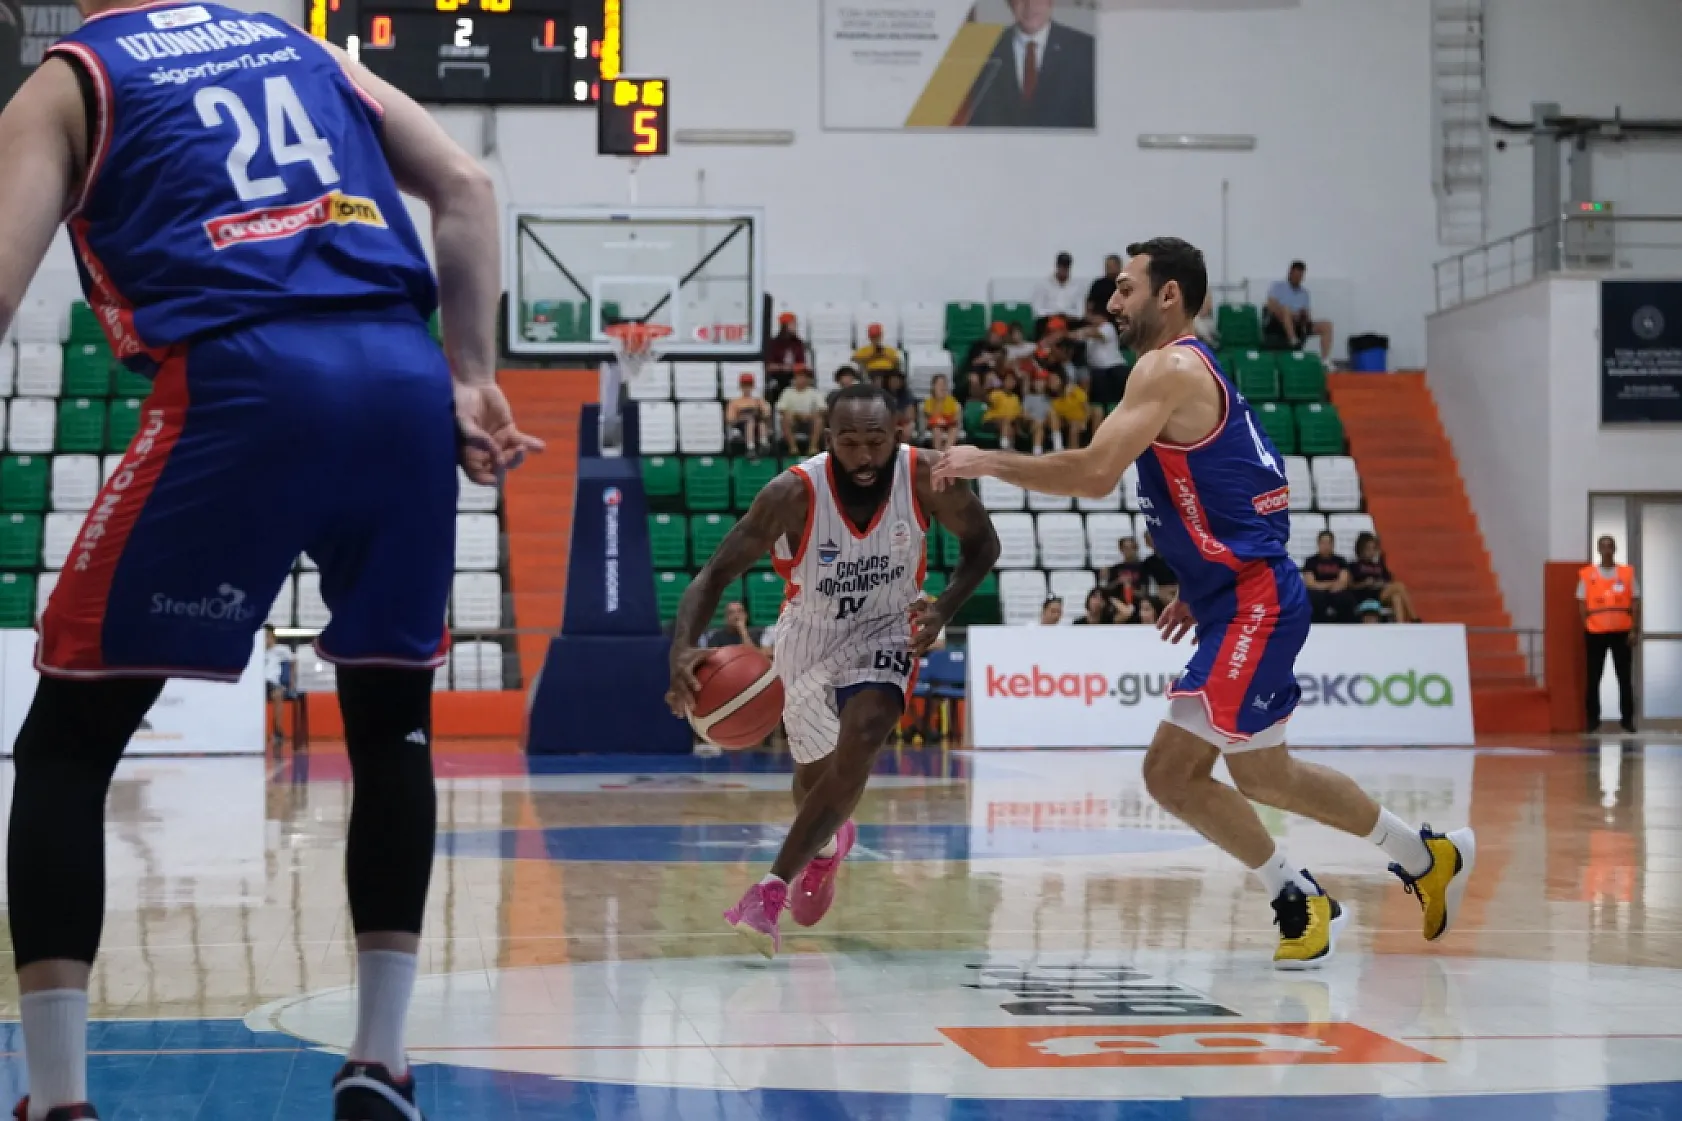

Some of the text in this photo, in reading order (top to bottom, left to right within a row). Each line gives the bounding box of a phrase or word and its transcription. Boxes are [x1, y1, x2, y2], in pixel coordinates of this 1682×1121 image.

[454, 17, 473, 47] 2
[193, 75, 341, 202] 24
[633, 109, 658, 153] 5
